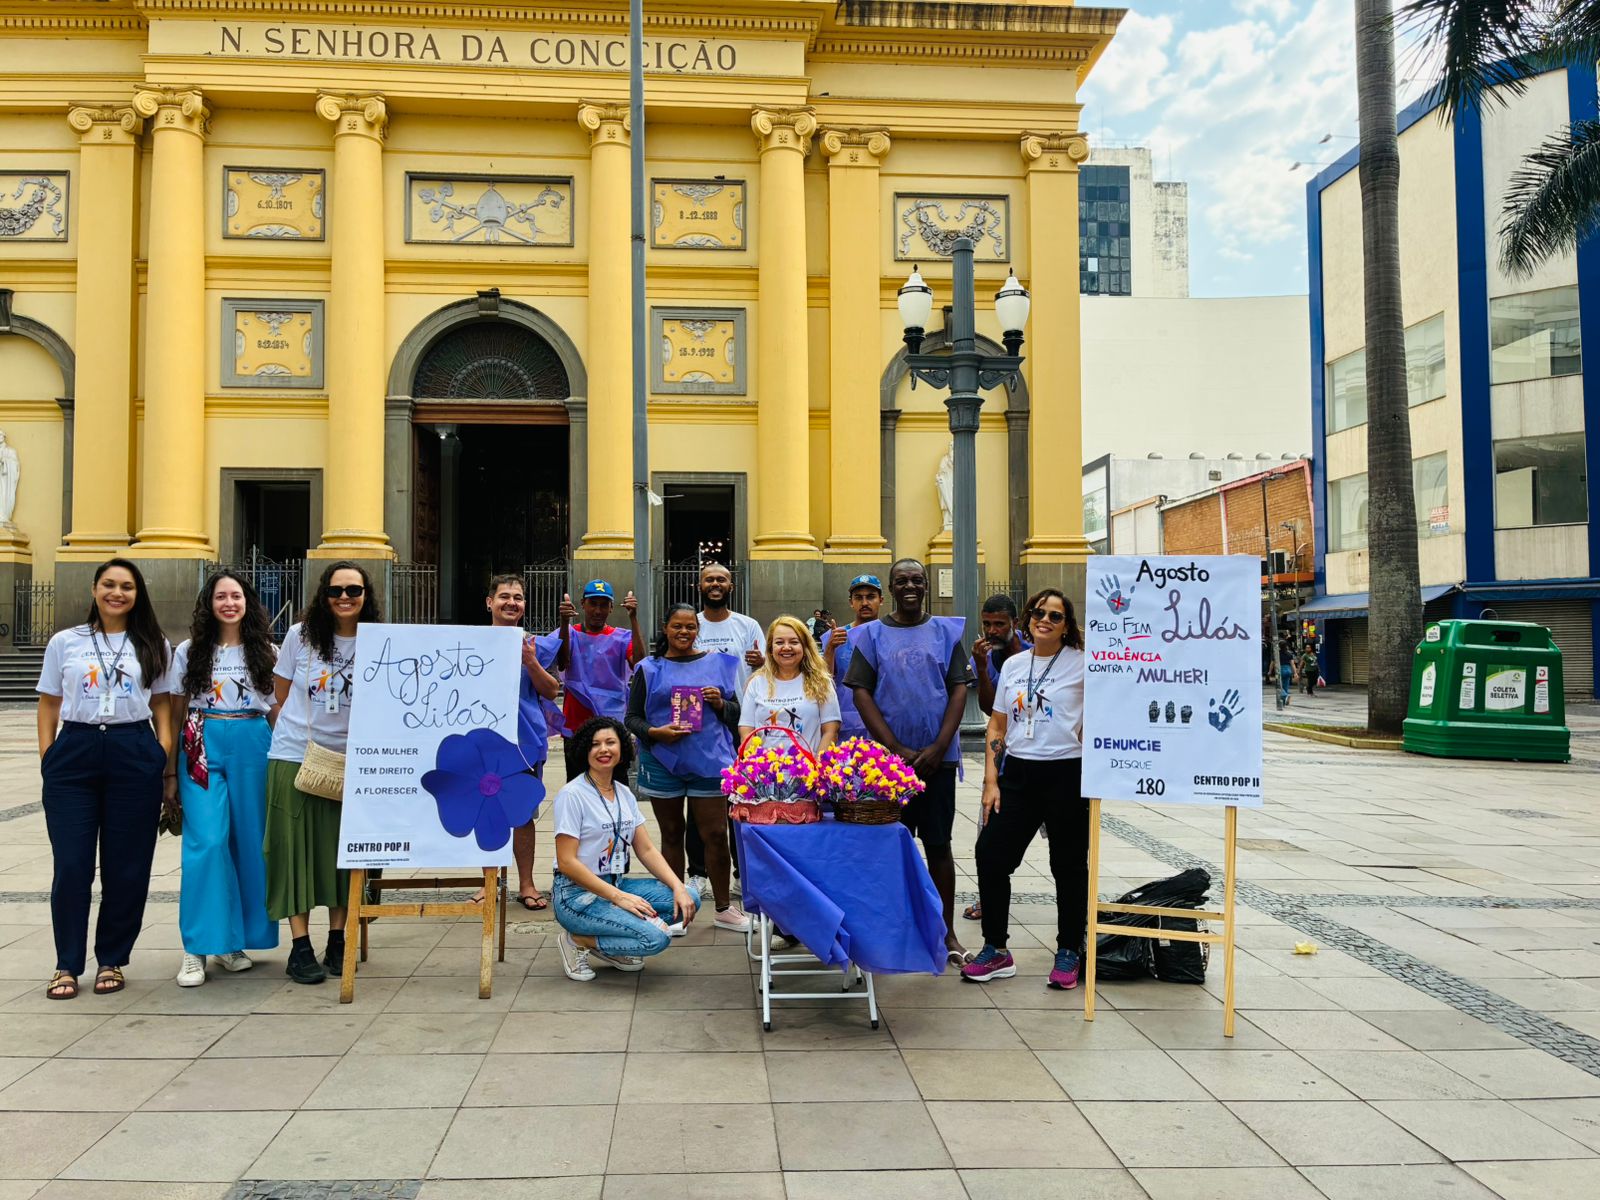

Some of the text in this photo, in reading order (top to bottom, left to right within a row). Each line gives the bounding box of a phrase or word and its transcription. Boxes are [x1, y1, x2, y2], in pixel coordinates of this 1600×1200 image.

[221, 26, 249, 52] N.
[265, 27, 441, 60] SENHORA
[461, 34, 508, 63] DA
[1136, 559, 1210, 589] Agosto
[1161, 589, 1251, 643] Lilás
[1089, 616, 1152, 635] PELO FIM
[1108, 637, 1123, 648] DA
[1091, 647, 1162, 662] VIOLÊNCIA
[363, 637, 495, 706] Agosto
[1088, 663, 1208, 685] CONTRA A MULHER!
[403, 681, 507, 729] Lilás
[355, 747, 418, 755] TODA MULHER
[358, 767, 414, 775] TEM DIREITO
[1110, 758, 1152, 770] DISQUE
[1135, 777, 1166, 796] 180
[1193, 775, 1230, 787] CENTRO
[1231, 776, 1251, 787] POP
[355, 787, 418, 795] A FLORESCER
[347, 842, 383, 852] CENTRO
[384, 842, 402, 852] POP
